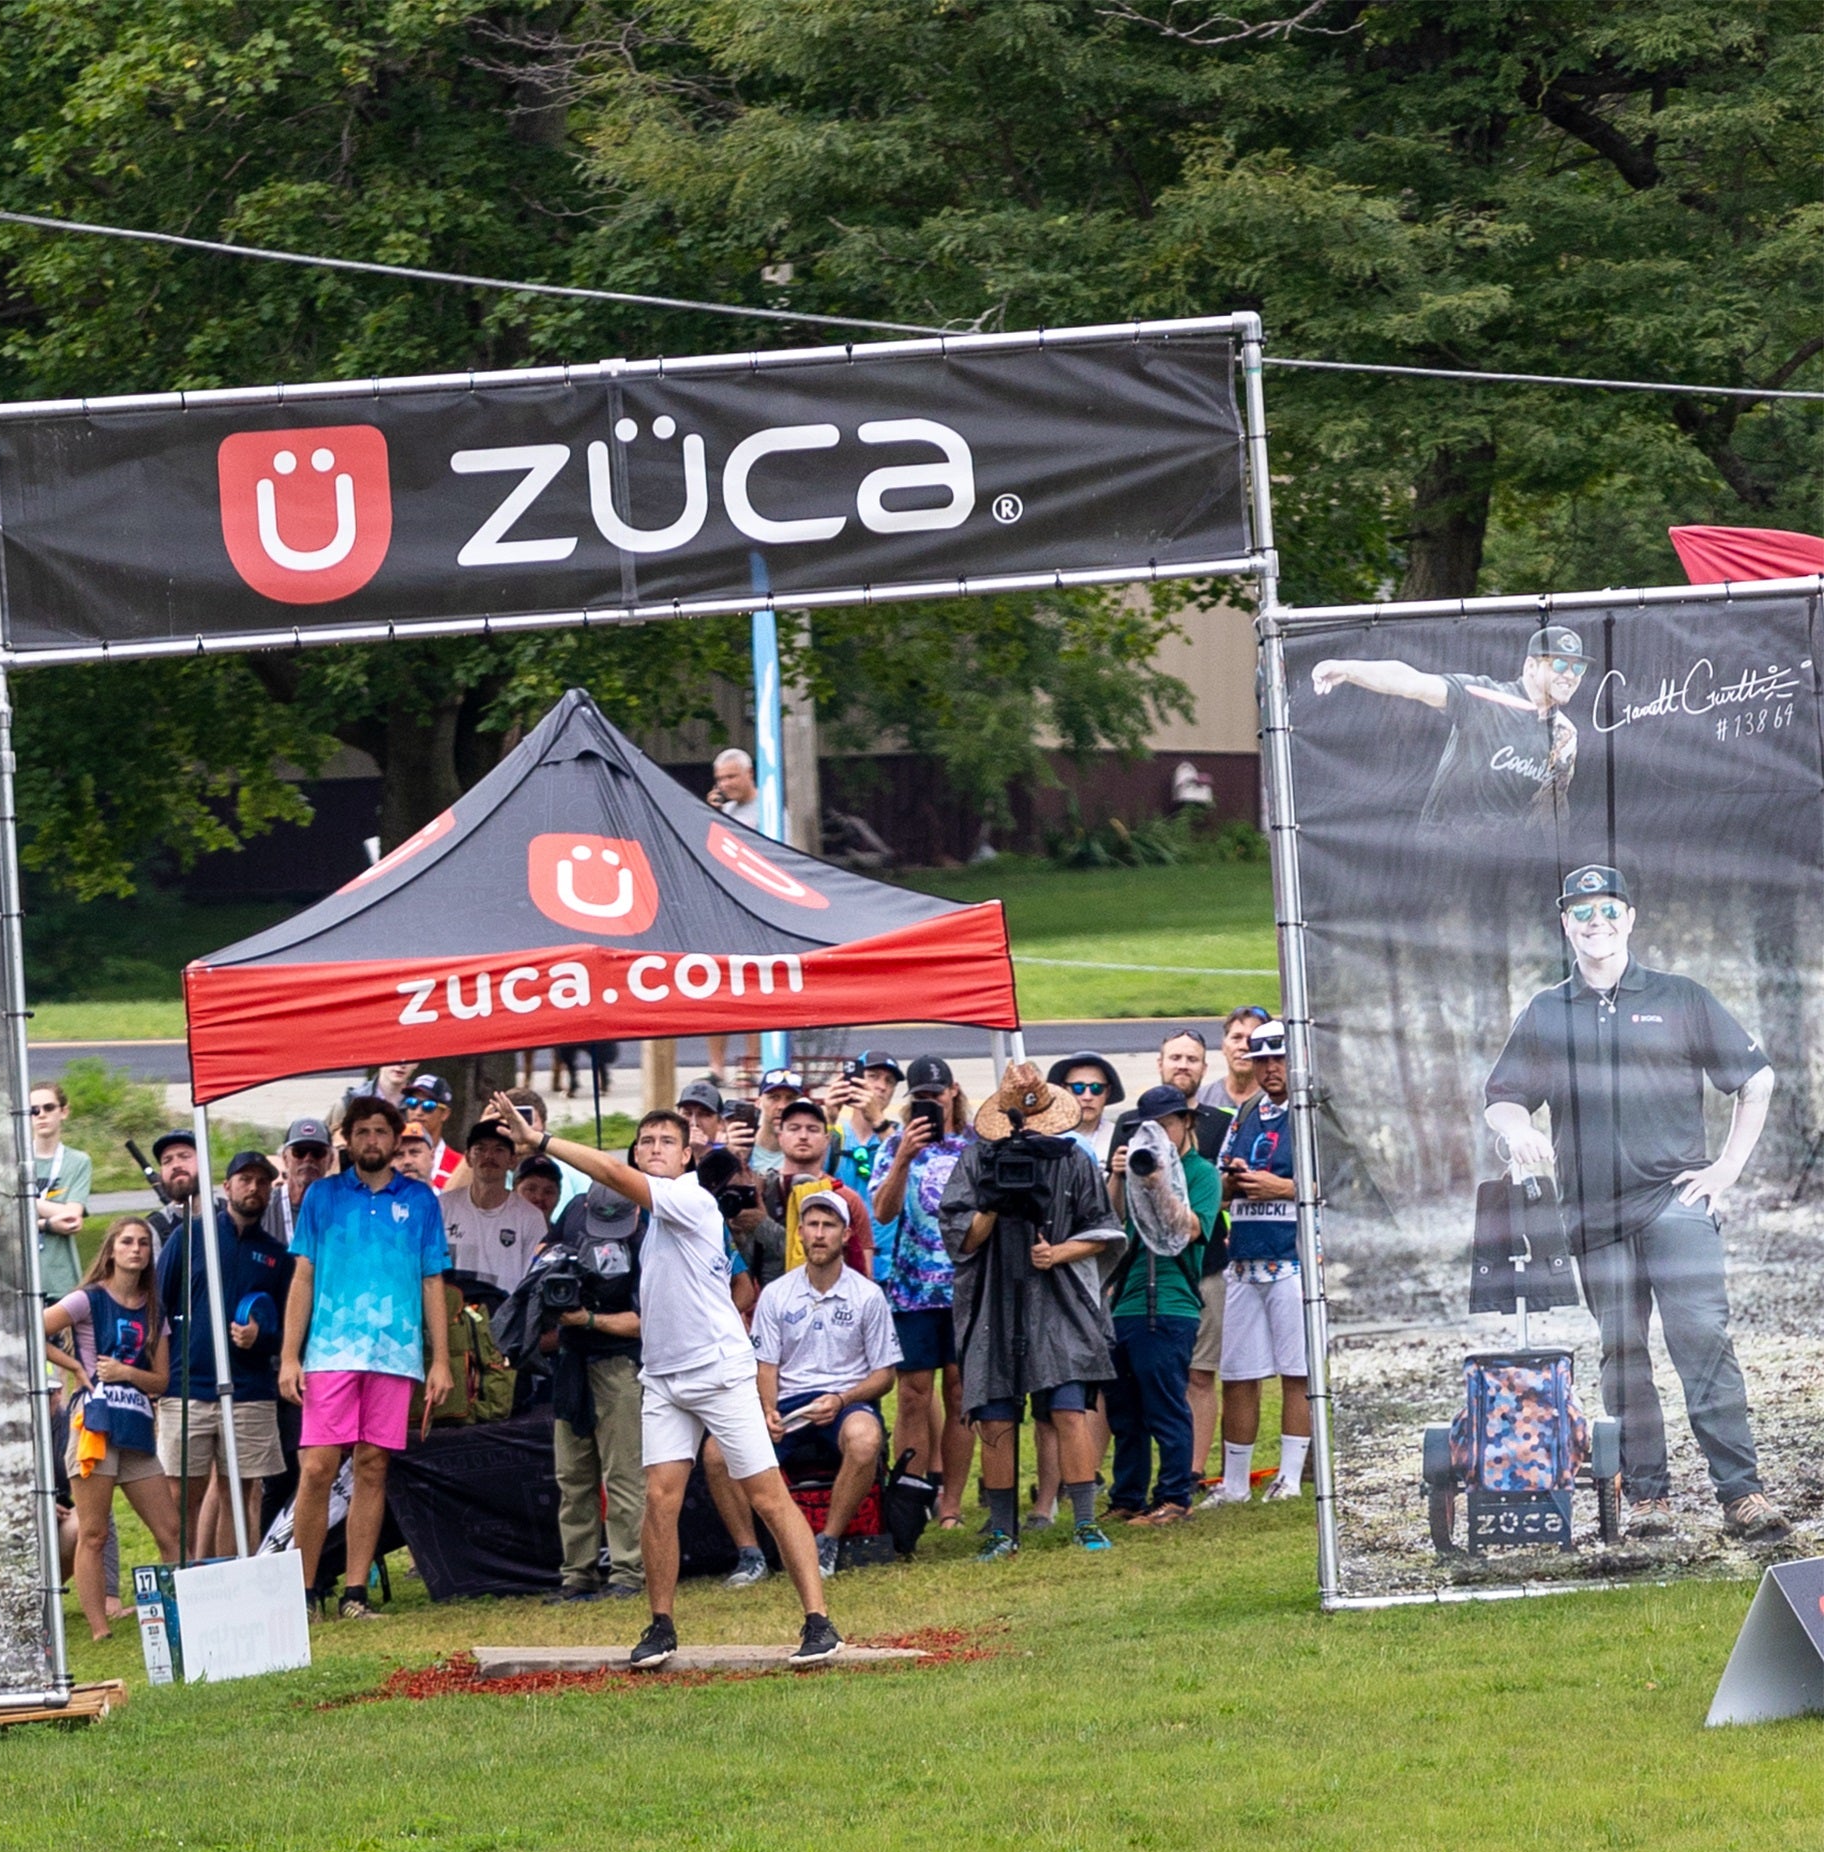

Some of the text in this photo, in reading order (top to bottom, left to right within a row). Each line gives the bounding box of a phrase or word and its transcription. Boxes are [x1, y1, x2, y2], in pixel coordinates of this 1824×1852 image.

[395, 952, 804, 1026] zuca.com
[1236, 1202, 1287, 1216] WYSOCKI
[139, 1574, 153, 1592] 17
